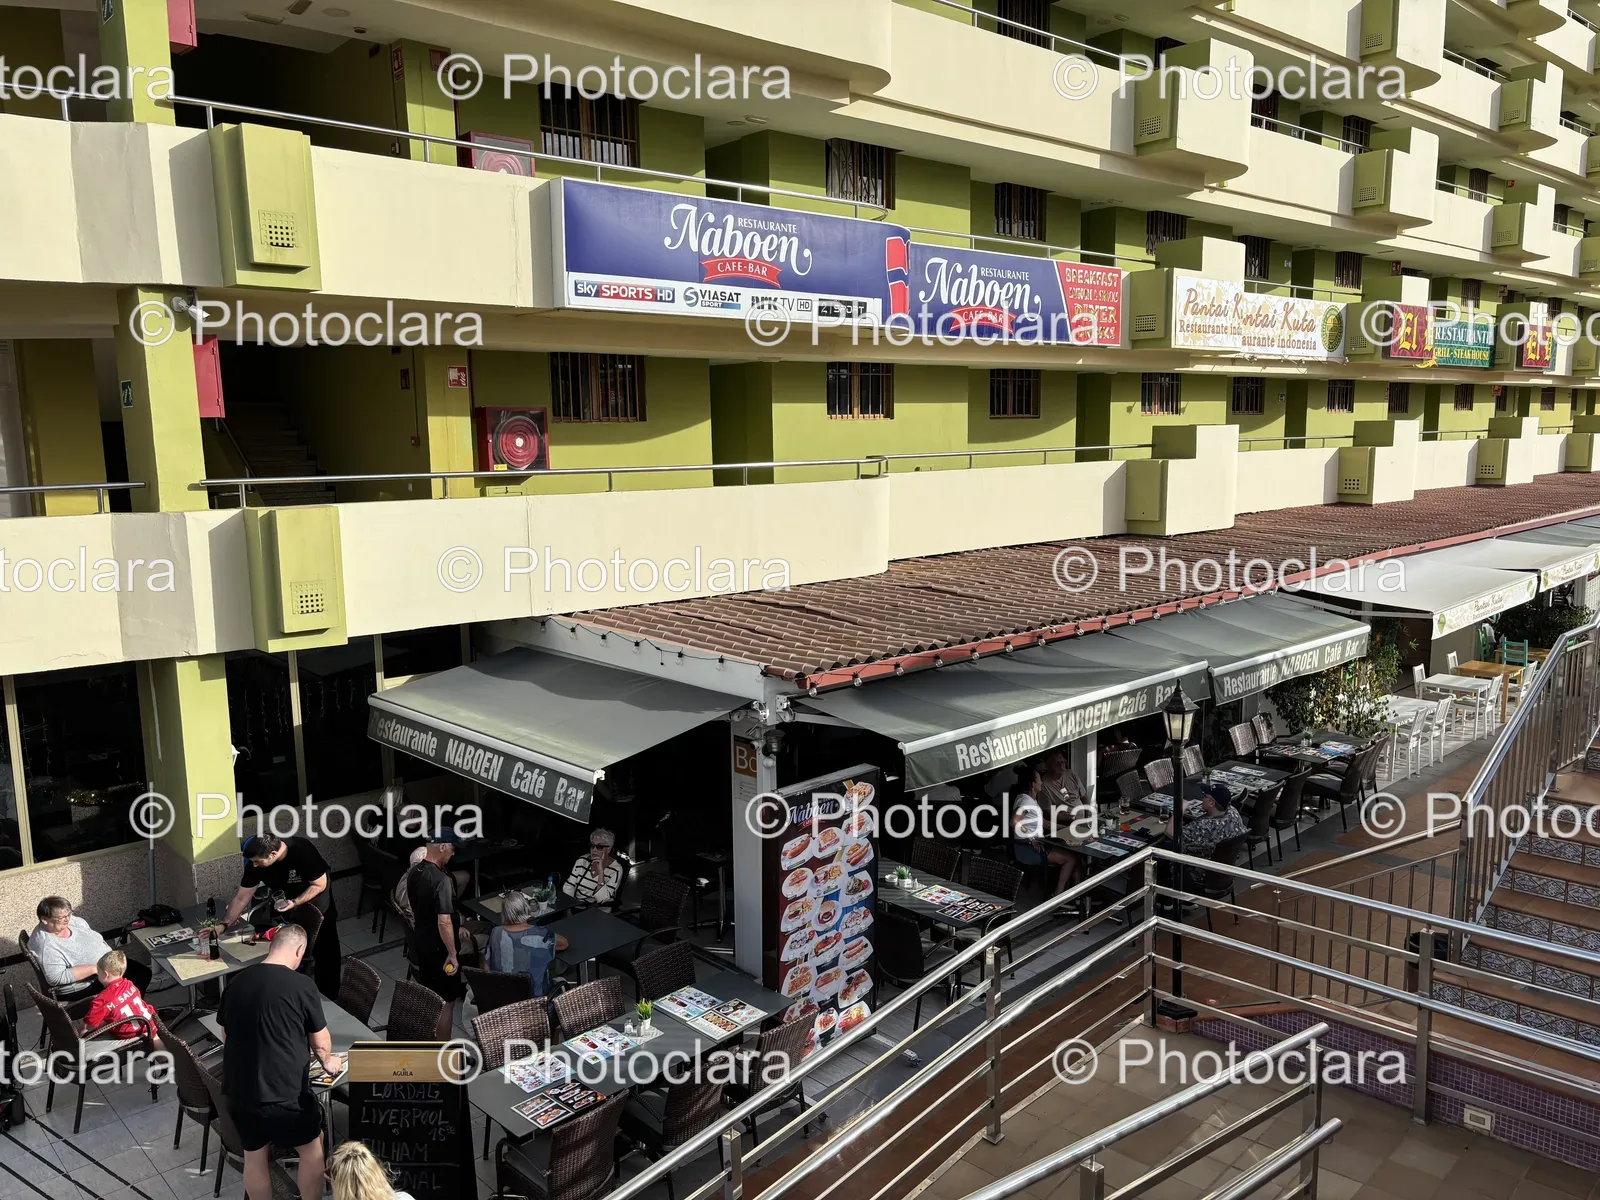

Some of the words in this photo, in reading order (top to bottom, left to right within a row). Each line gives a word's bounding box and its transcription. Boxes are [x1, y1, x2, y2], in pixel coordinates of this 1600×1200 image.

[737, 217, 798, 234] RESTAURANTE
[663, 203, 813, 276] Naboen
[717, 261, 768, 277] CAFE-BAR
[980, 266, 1030, 281] RESTAURANTE
[1065, 267, 1119, 287] BREAKFAST
[577, 281, 598, 297] sky
[601, 284, 653, 300] SPORTS
[657, 288, 673, 301] HD
[700, 289, 742, 303] VIASAT
[918, 257, 1042, 321] Naboen
[799, 301, 810, 310] HD
[1183, 287, 1229, 319] Pantai
[1178, 319, 1228, 335] Restaurante
[1281, 301, 1317, 333] Kuta
[1277, 339, 1317, 351] indonesia
[1223, 663, 1277, 698] Restaurante
[1281, 649, 1320, 676] NABOEN
[1324, 643, 1342, 664] Café
[1344, 639, 1360, 658] Bar
[955, 718, 1047, 771] Restaurante
[1056, 700, 1112, 739] NABOEN
[1118, 688, 1148, 718] Café
[444, 738, 504, 783] NABOEN
[510, 761, 546, 799] Café
[553, 777, 585, 813] Bar
[361, 1106, 449, 1128] LIVERPOOL
